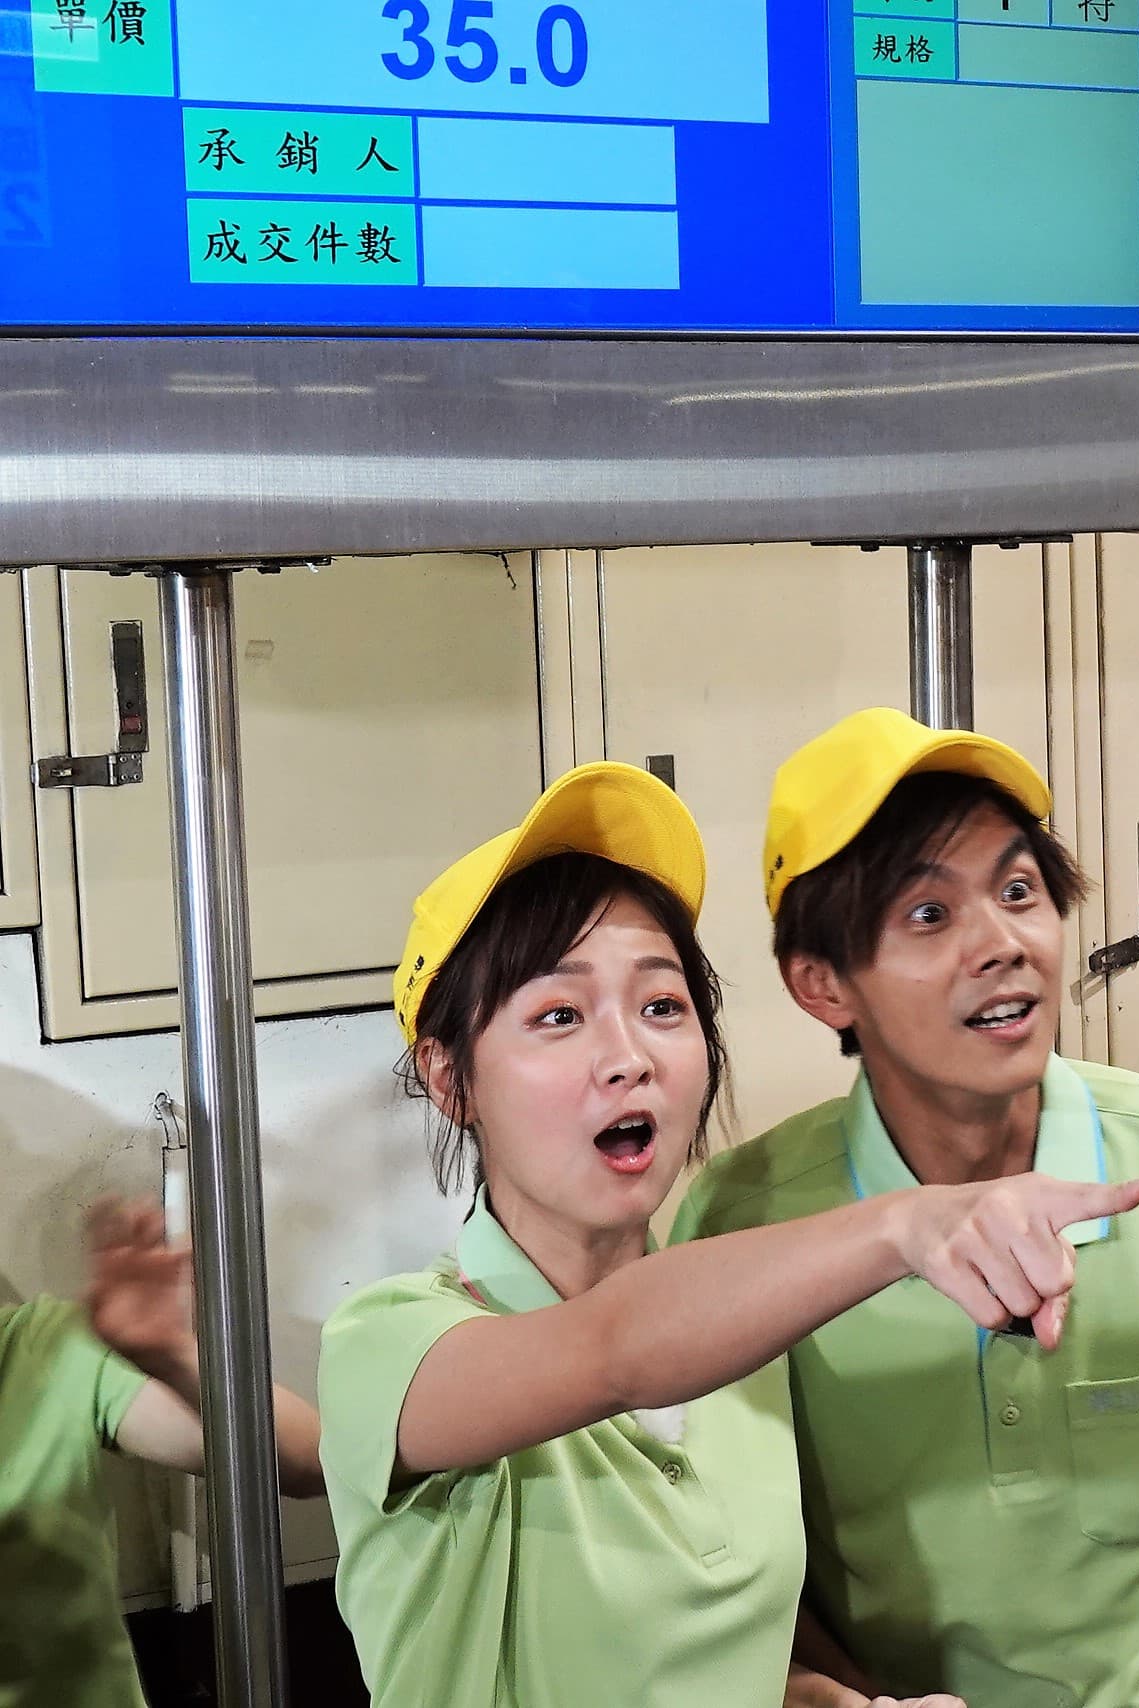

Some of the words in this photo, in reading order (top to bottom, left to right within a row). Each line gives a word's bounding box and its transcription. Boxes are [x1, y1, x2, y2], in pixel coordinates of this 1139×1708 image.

[49, 0, 147, 46] 單價
[380, 0, 589, 87] 35.0
[872, 34, 934, 64] 規格
[198, 127, 400, 174] 承銷人
[203, 219, 402, 265] 成交件數
